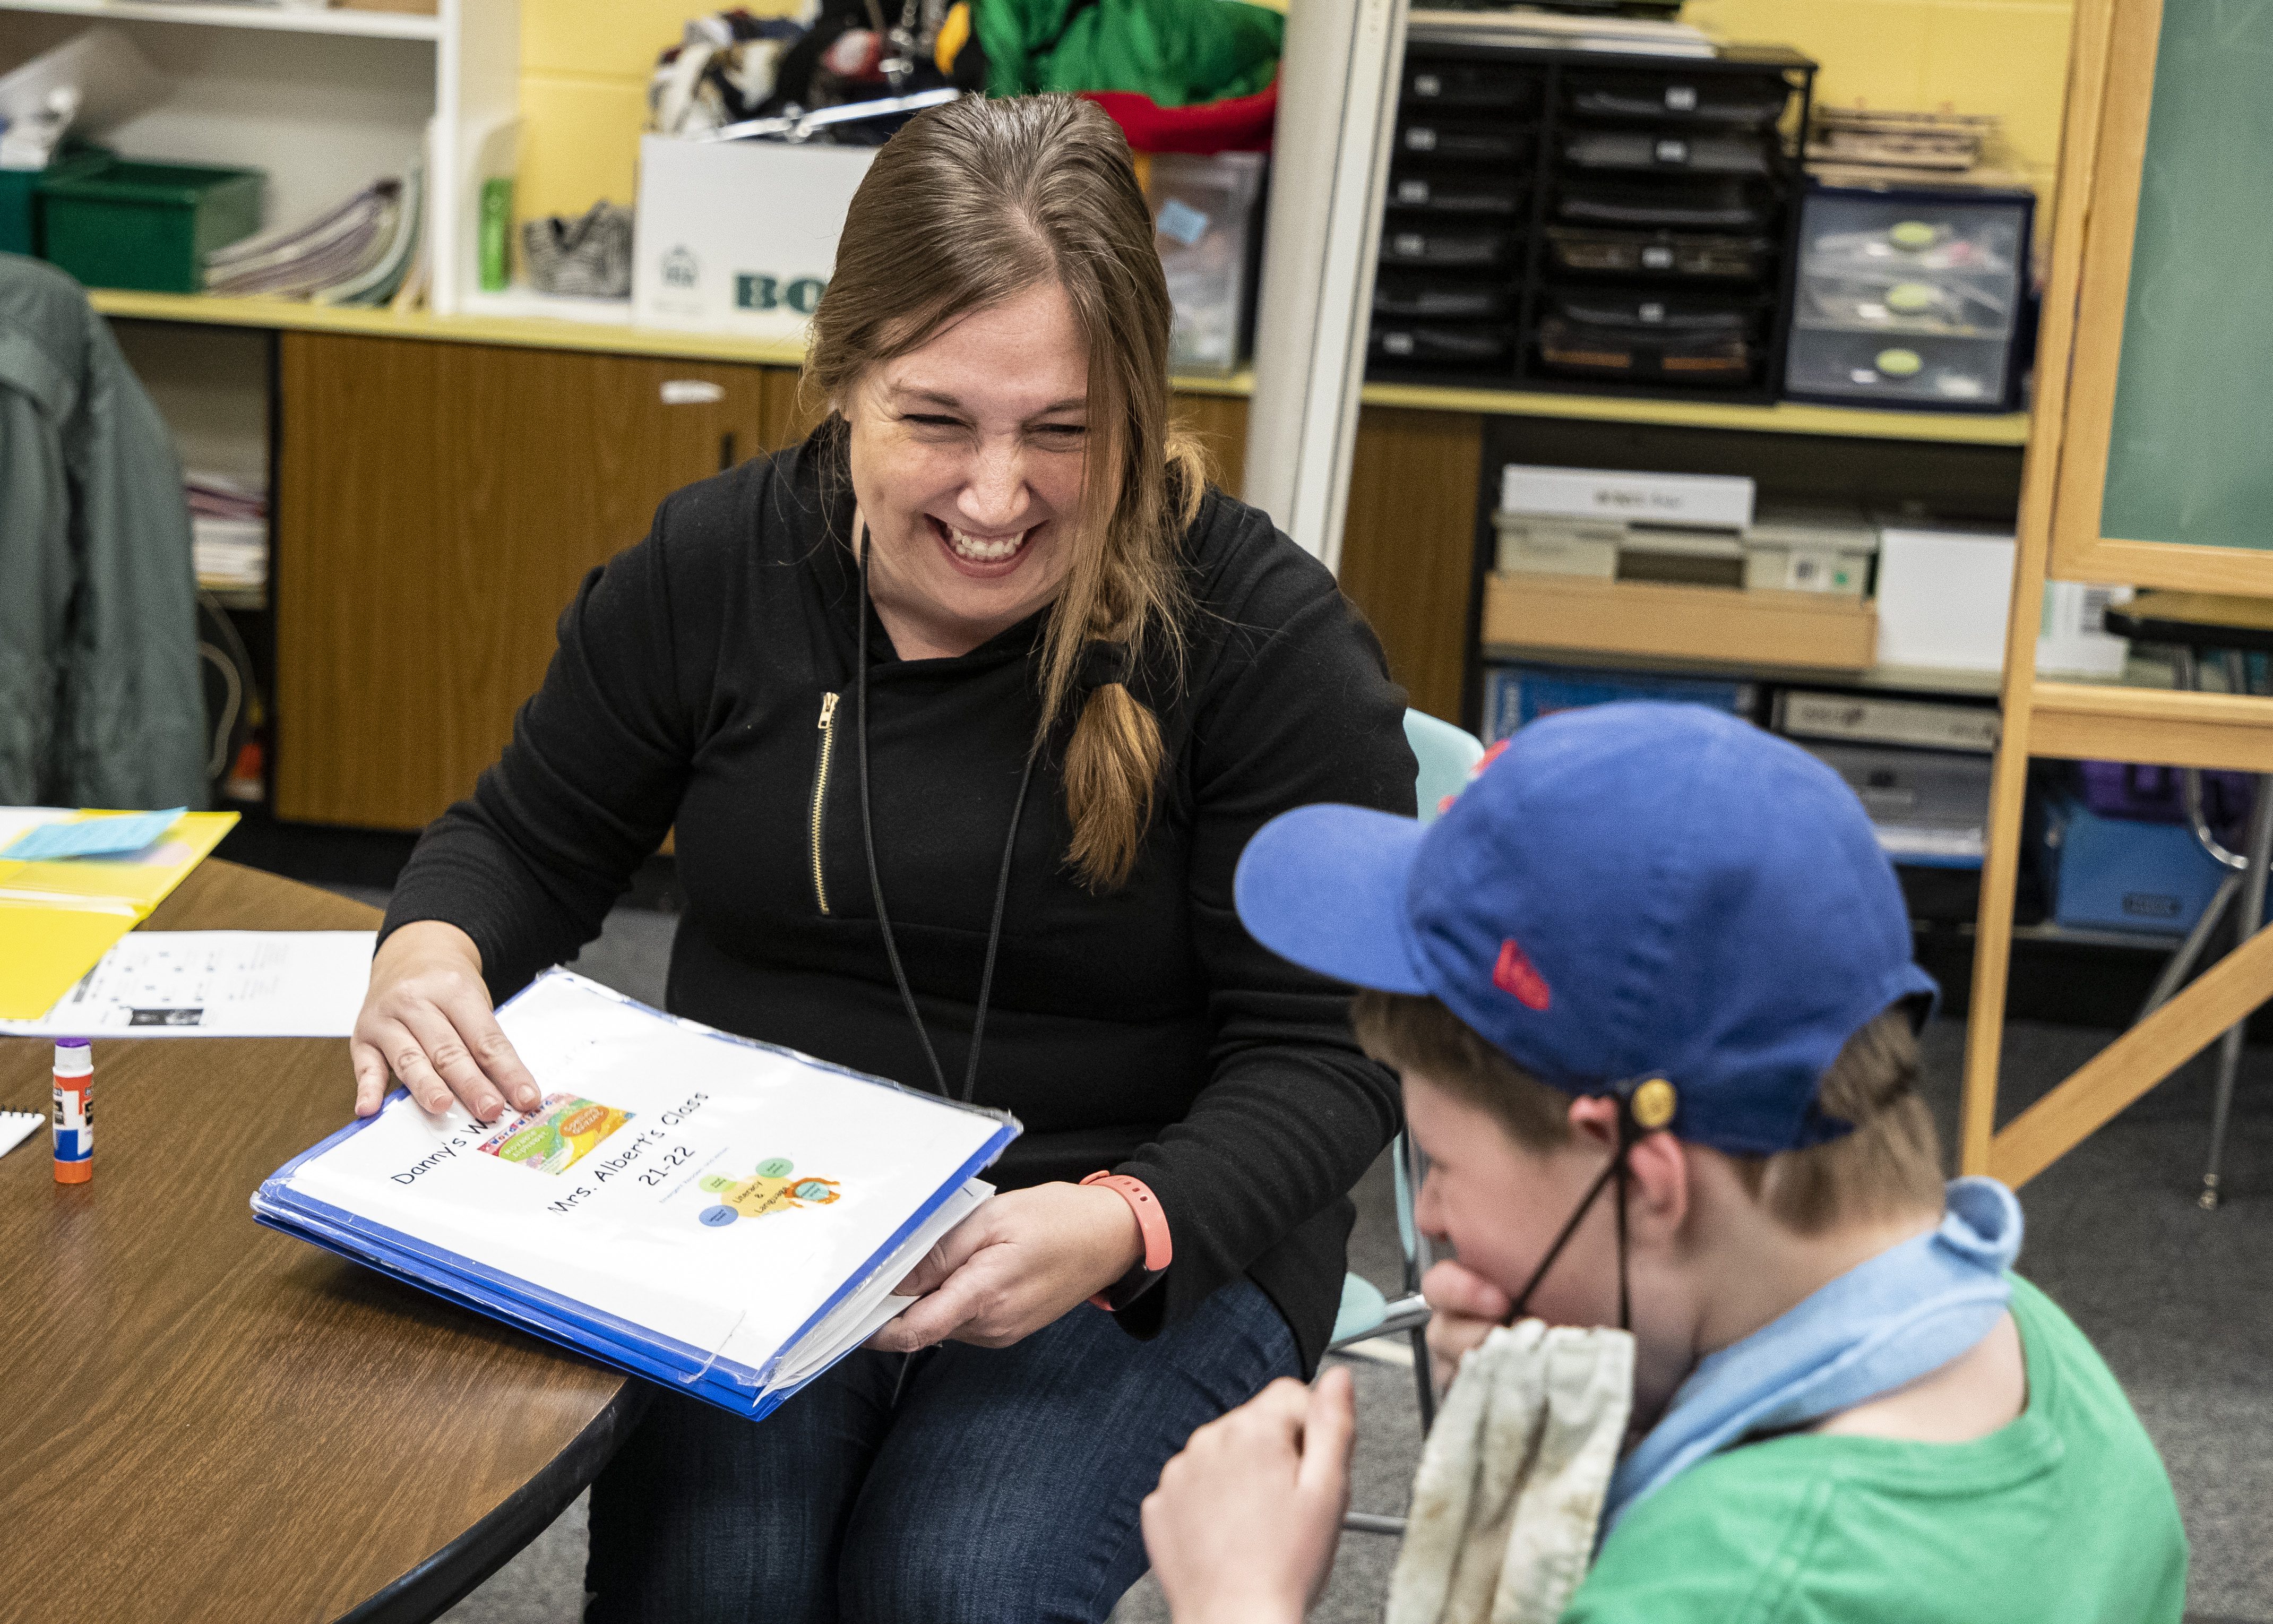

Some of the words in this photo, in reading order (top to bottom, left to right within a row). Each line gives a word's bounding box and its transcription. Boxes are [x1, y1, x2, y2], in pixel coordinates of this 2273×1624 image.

[391, 1138, 467, 1184] Danny's
[548, 1187, 597, 1215] Mrs.
[595, 1129, 665, 1182] Albert's
[661, 1092, 709, 1125] Class
[639, 1146, 695, 1186] 21-22
